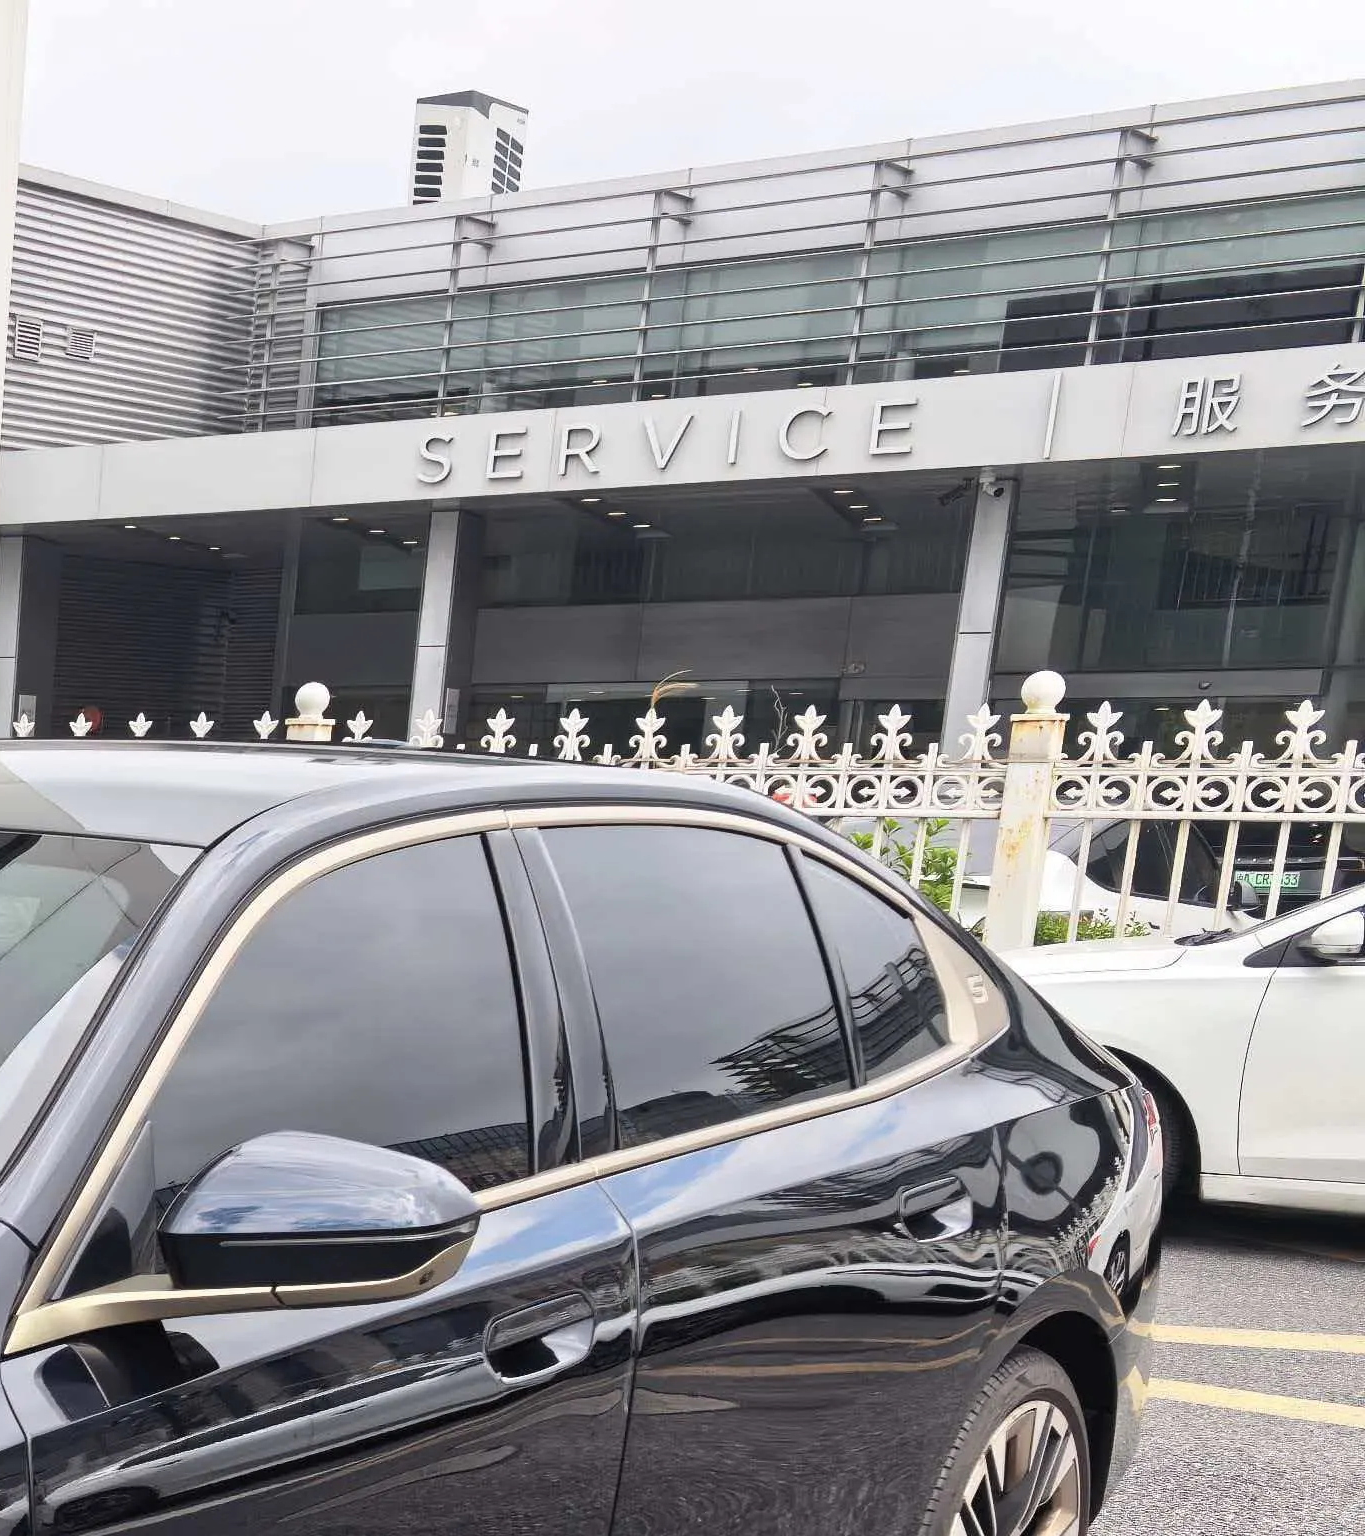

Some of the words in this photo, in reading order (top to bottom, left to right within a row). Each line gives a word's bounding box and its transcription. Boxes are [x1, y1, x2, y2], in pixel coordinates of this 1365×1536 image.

[1171, 364, 1365, 437] 服务
[416, 398, 919, 484] SERVICE
[1256, 873, 1298, 886] CR33
